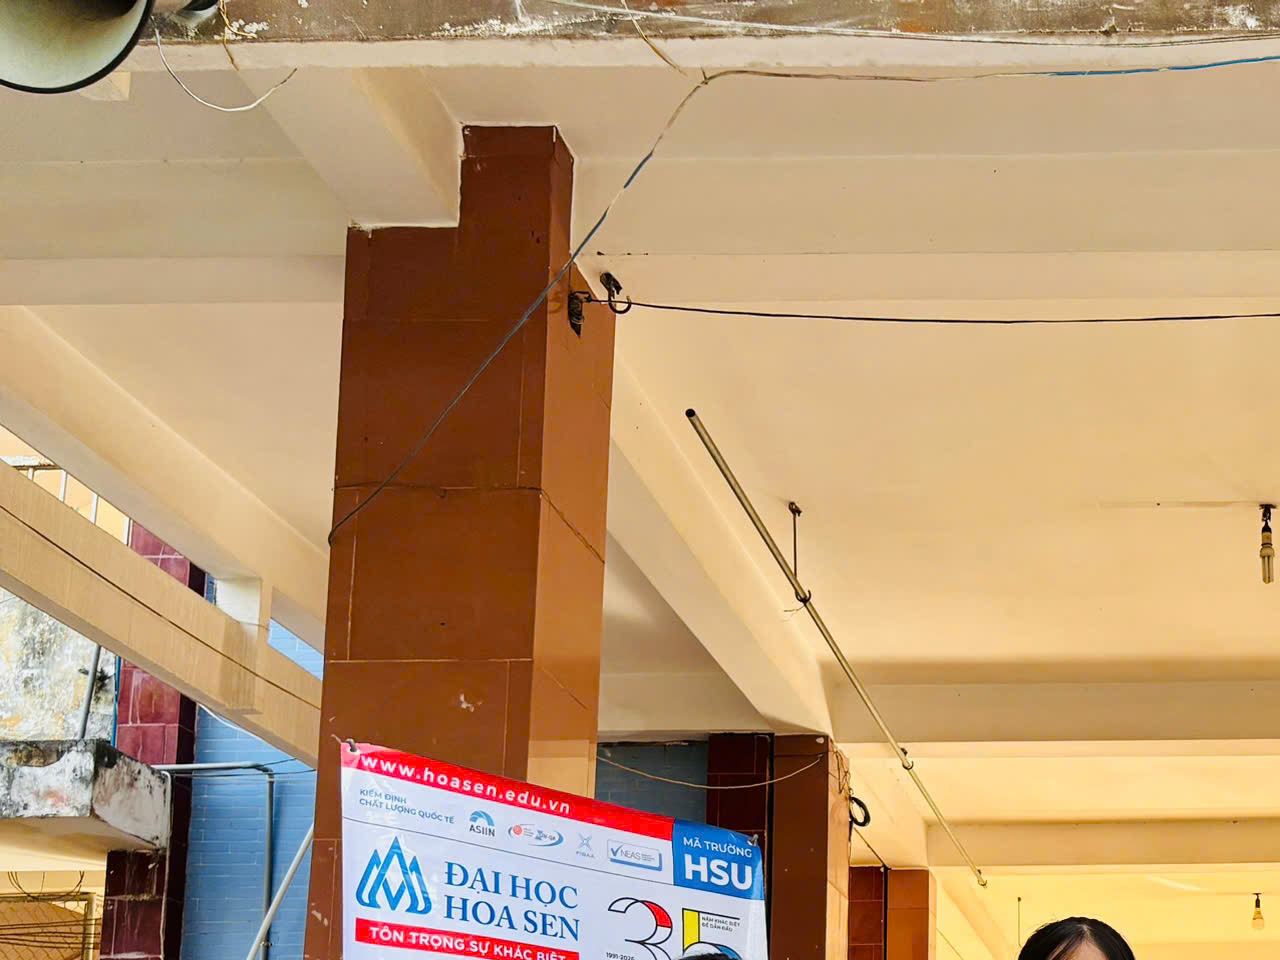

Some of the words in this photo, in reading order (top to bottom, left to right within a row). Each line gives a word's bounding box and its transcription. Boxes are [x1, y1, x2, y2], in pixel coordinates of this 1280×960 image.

[360, 755, 570, 814] www.hoasen.edu.vn
[469, 824, 496, 837] ASIIN
[683, 836, 702, 848] MÃ
[704, 840, 752, 858] TRƯỜNG
[444, 861, 501, 895] ĐẠI
[509, 874, 578, 909] HỌC
[684, 853, 752, 891] HSU
[444, 895, 518, 931] HOA
[523, 909, 580, 942] SEN
[369, 924, 404, 943] TÔN
[409, 931, 465, 951] TRỌNG
[469, 940, 490, 957] SỰ
